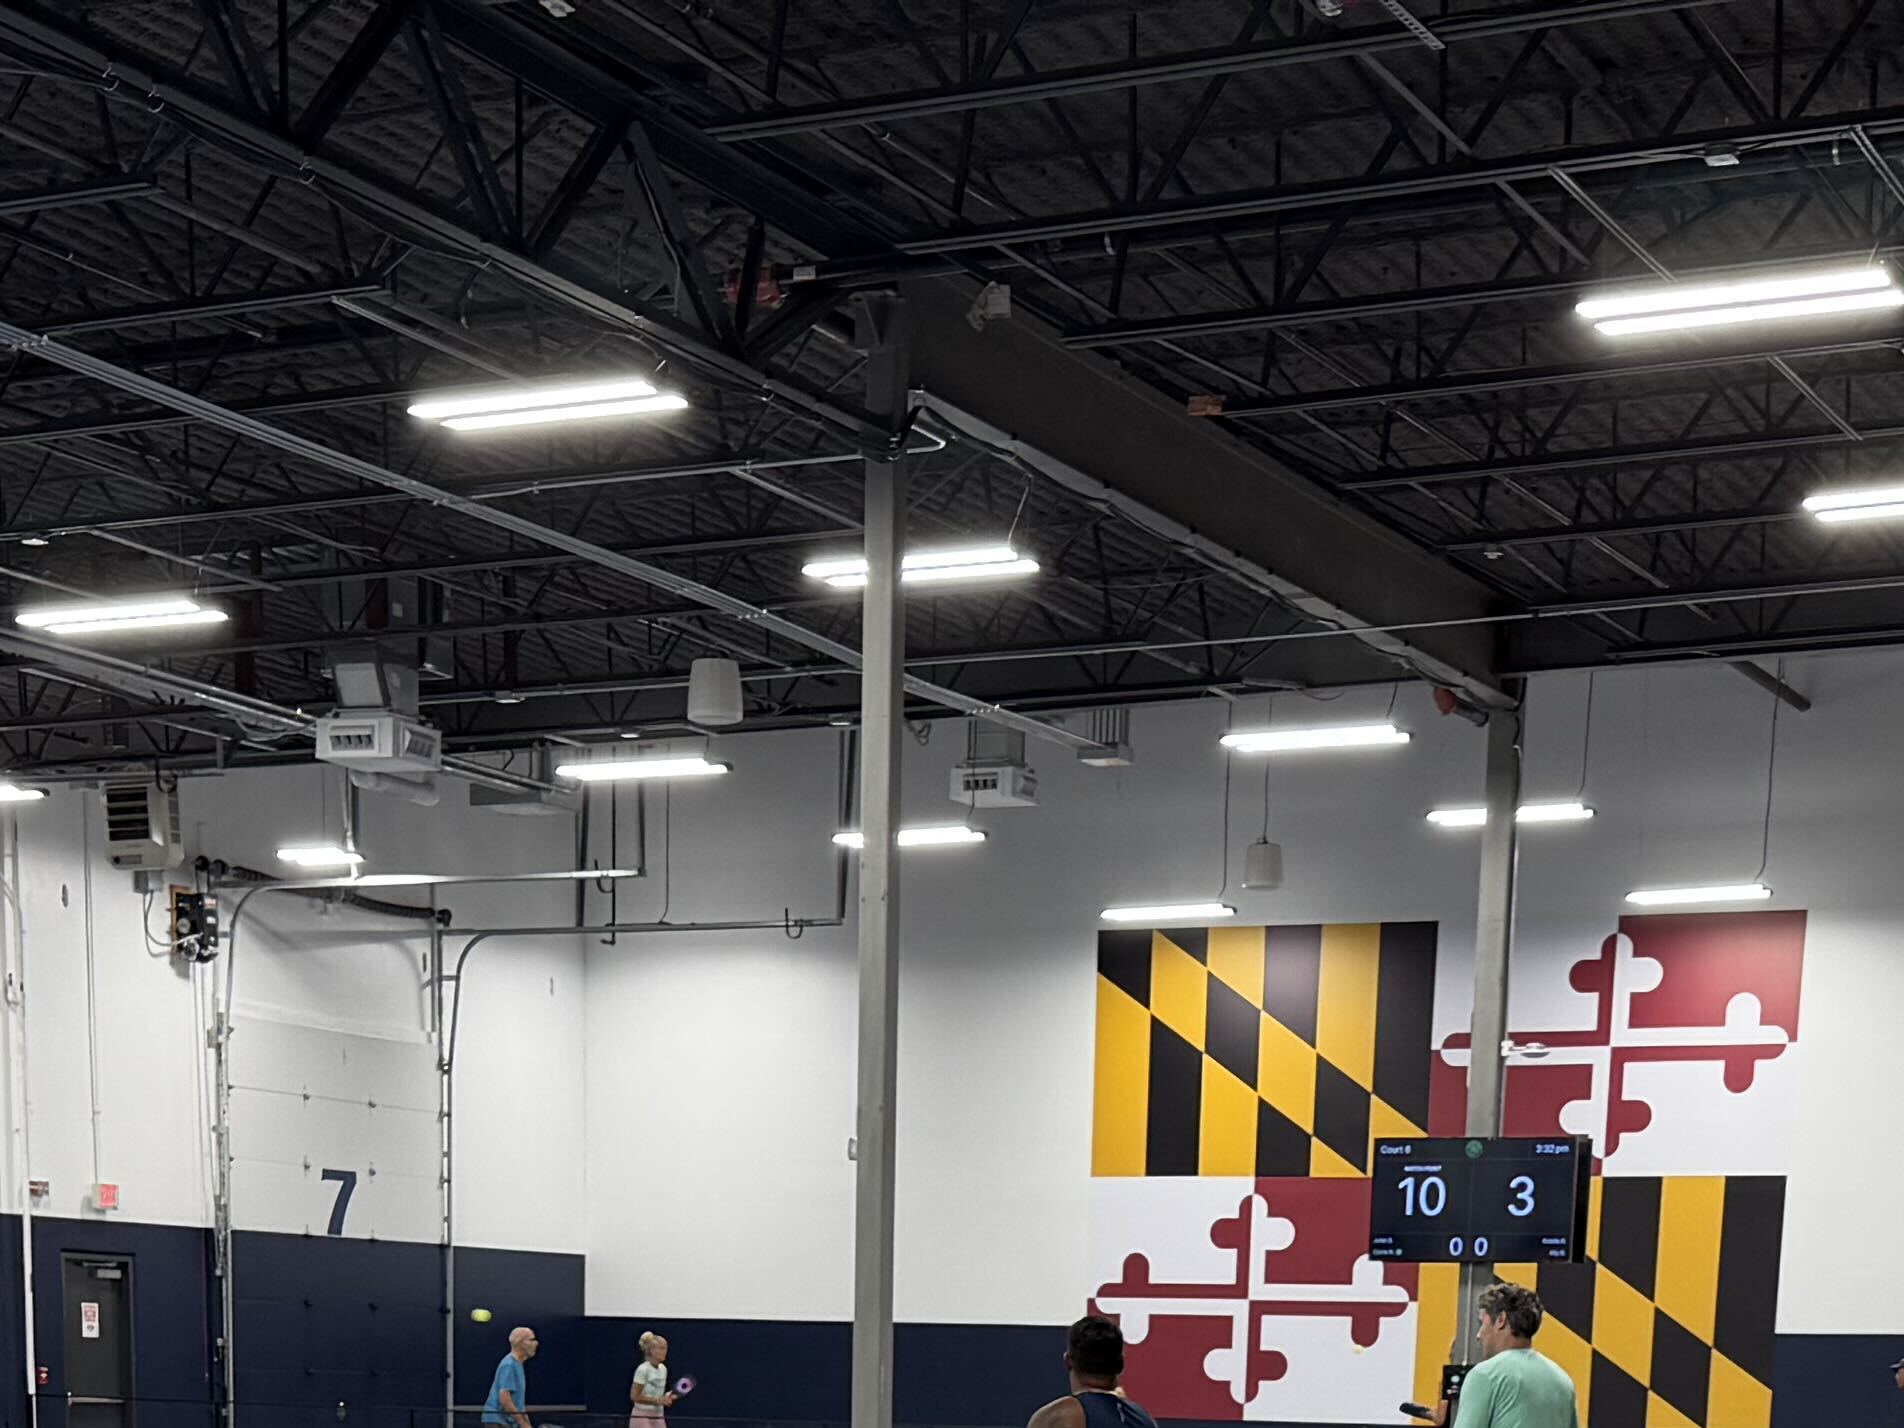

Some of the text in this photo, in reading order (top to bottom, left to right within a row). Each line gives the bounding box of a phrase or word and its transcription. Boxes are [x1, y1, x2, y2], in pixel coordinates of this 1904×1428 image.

[321, 1168, 357, 1236] 7
[1398, 1176, 1447, 1217] 10
[1507, 1175, 1536, 1217] 3
[1449, 1237, 1489, 1256] 0 0
